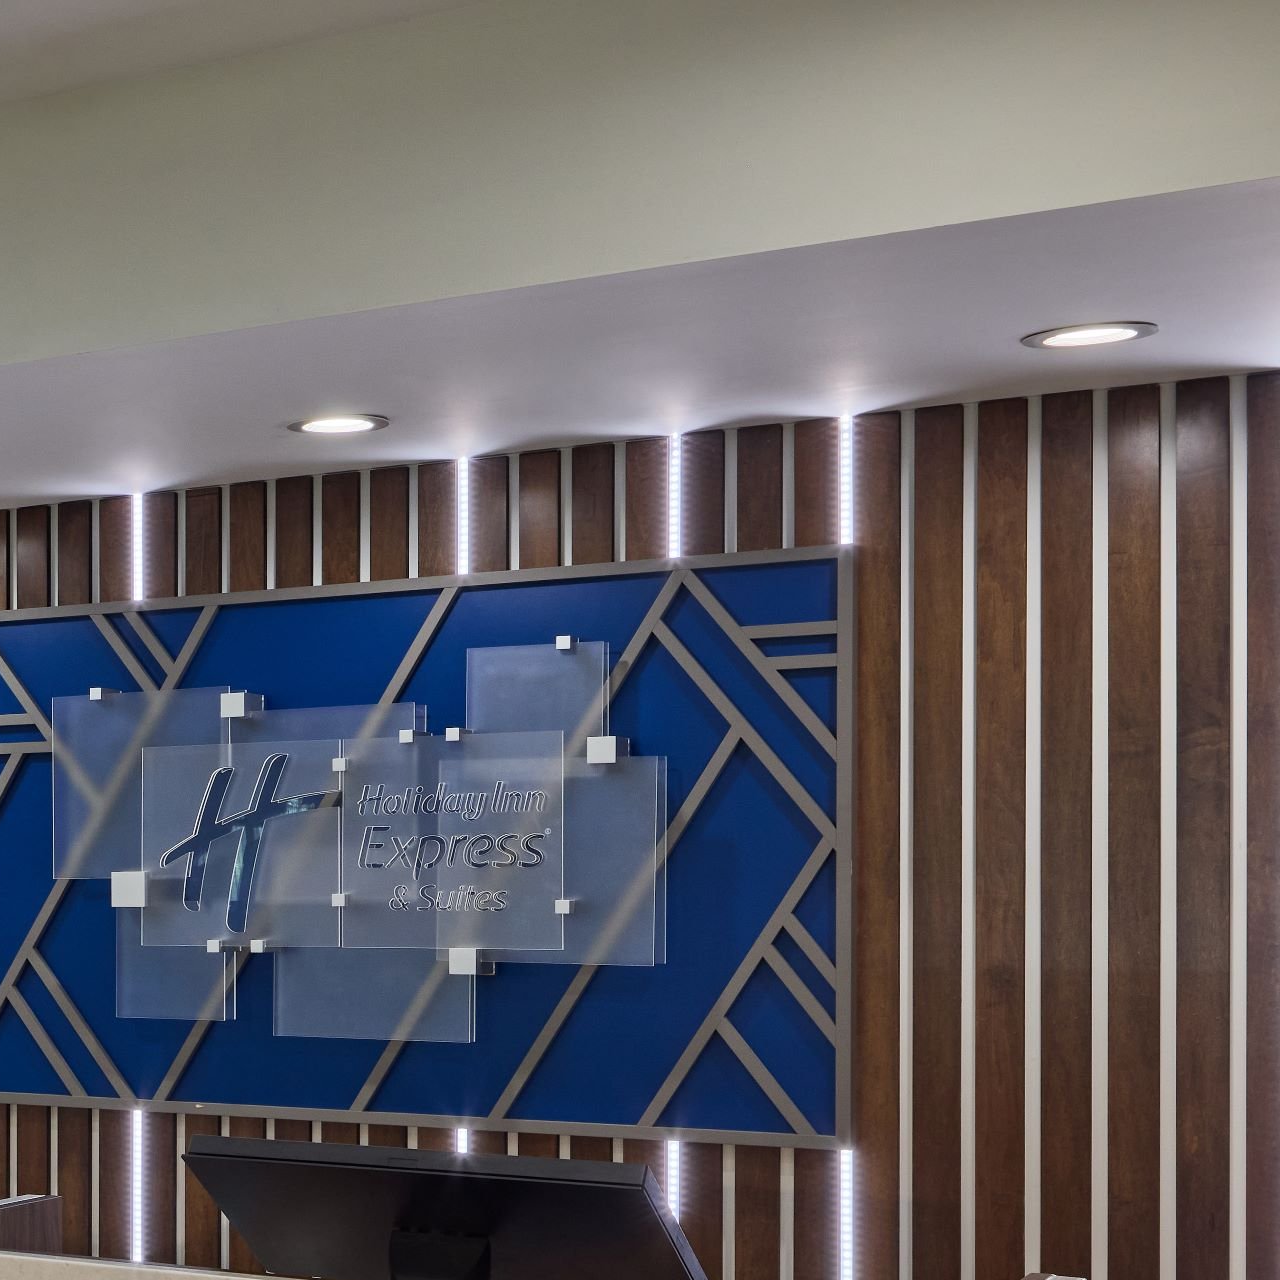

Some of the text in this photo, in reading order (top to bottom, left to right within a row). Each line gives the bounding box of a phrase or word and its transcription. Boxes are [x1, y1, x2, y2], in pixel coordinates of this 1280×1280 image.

[357, 780, 546, 821] Holiday Inn
[389, 884, 508, 912] & Suites
